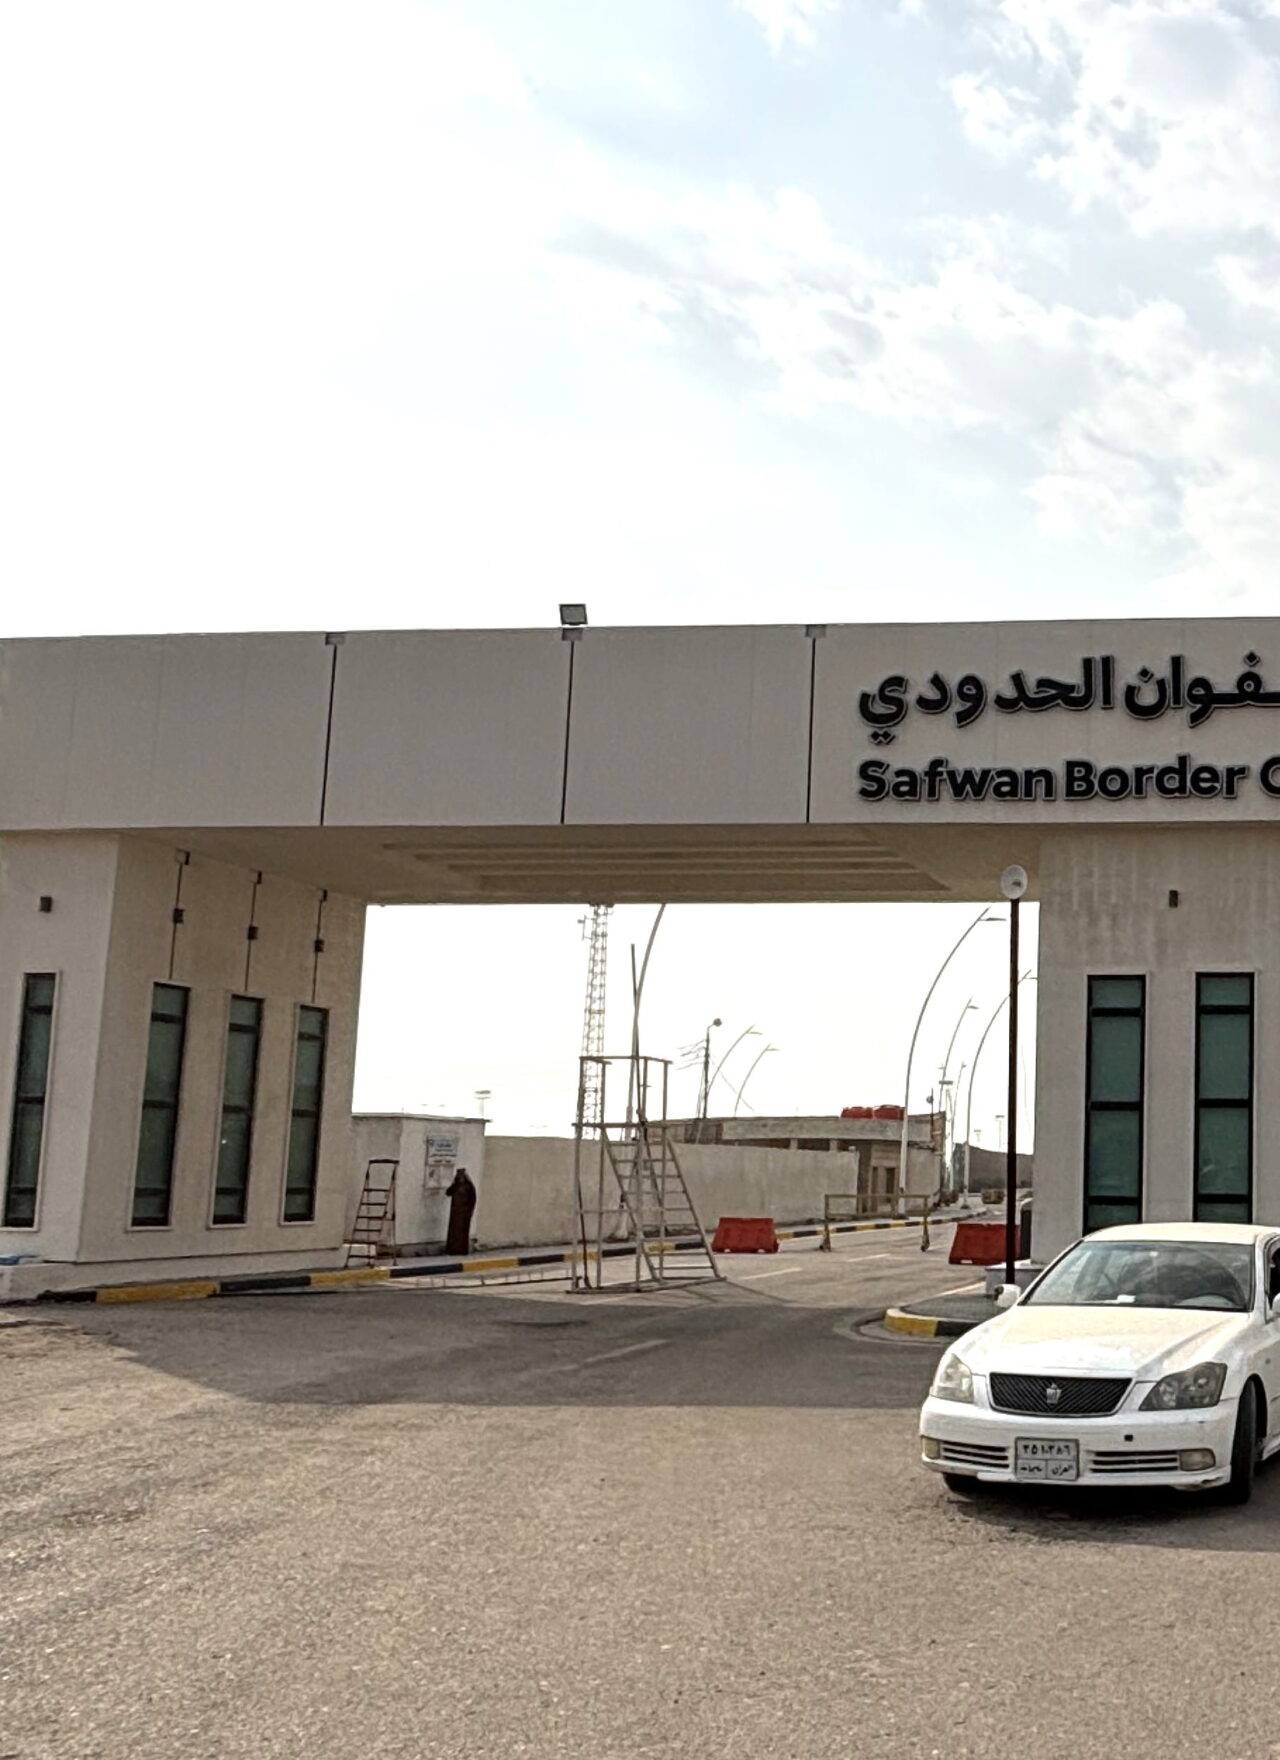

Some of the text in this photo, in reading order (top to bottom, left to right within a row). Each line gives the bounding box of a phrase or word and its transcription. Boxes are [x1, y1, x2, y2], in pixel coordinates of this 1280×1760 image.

[858, 654, 1115, 745] الحدودي
[858, 758, 1055, 801] Safwan
[1063, 754, 1250, 801] Border
